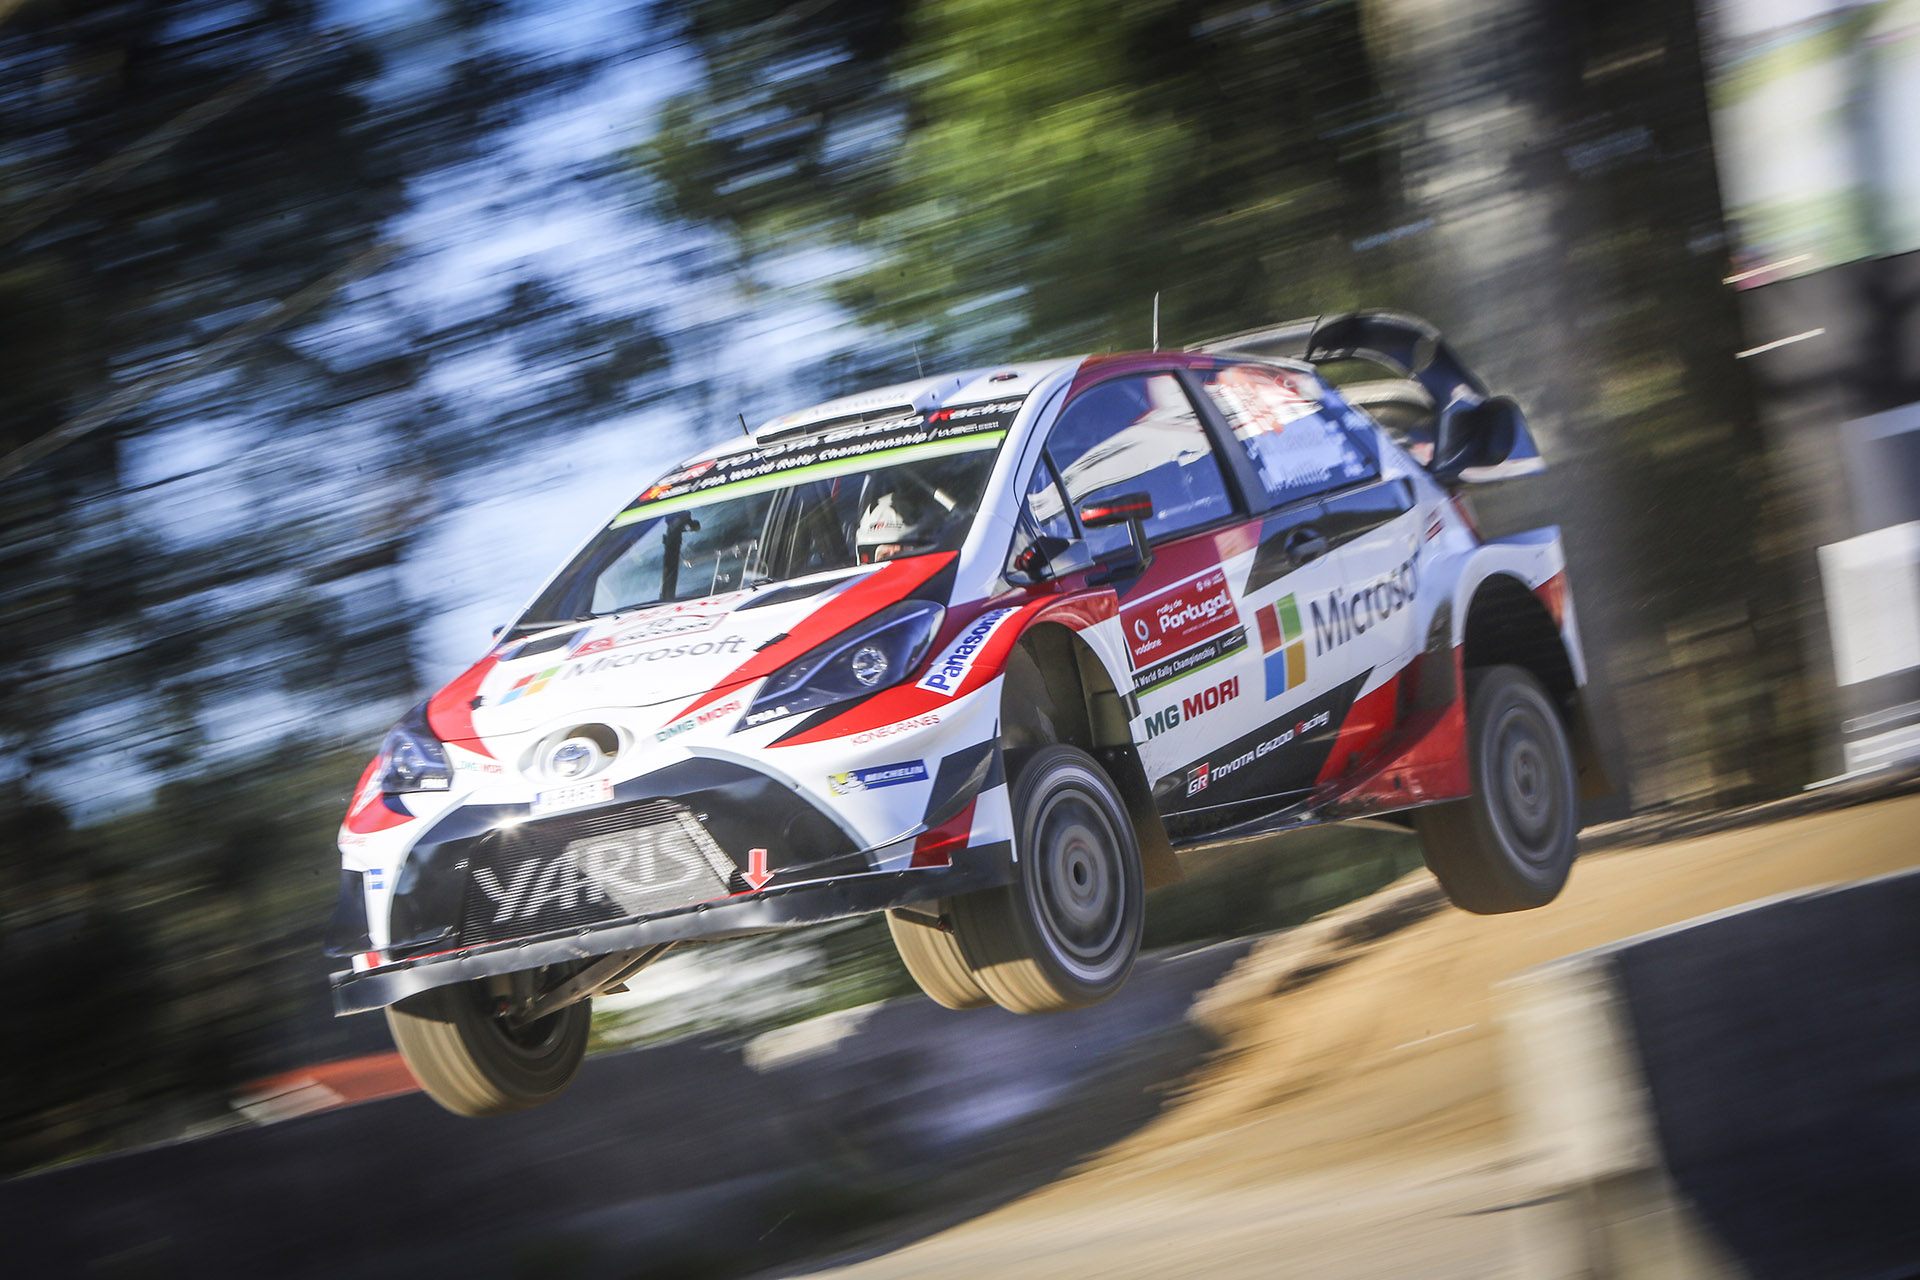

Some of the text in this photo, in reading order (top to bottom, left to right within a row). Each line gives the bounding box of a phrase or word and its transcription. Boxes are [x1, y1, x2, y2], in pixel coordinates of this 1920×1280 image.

[729, 459, 776, 482] World
[776, 452, 818, 471] Rally
[818, 431, 928, 461] Championship
[1159, 588, 1232, 633] Portugal
[561, 634, 746, 682] Microsoft
[924, 607, 1013, 691] Panasonic
[1140, 670, 1157, 686] World
[1157, 664, 1173, 680] Rally
[1173, 645, 1217, 672] Championship
[655, 700, 742, 742] DMG MORI
[851, 714, 940, 746] KONECRANES
[1144, 675, 1240, 740] MG MORI
[864, 765, 924, 783] MICHELIN
[1188, 710, 1330, 793] GR TOYOTA GAZOO Racing
[472, 821, 704, 924] YARIS
